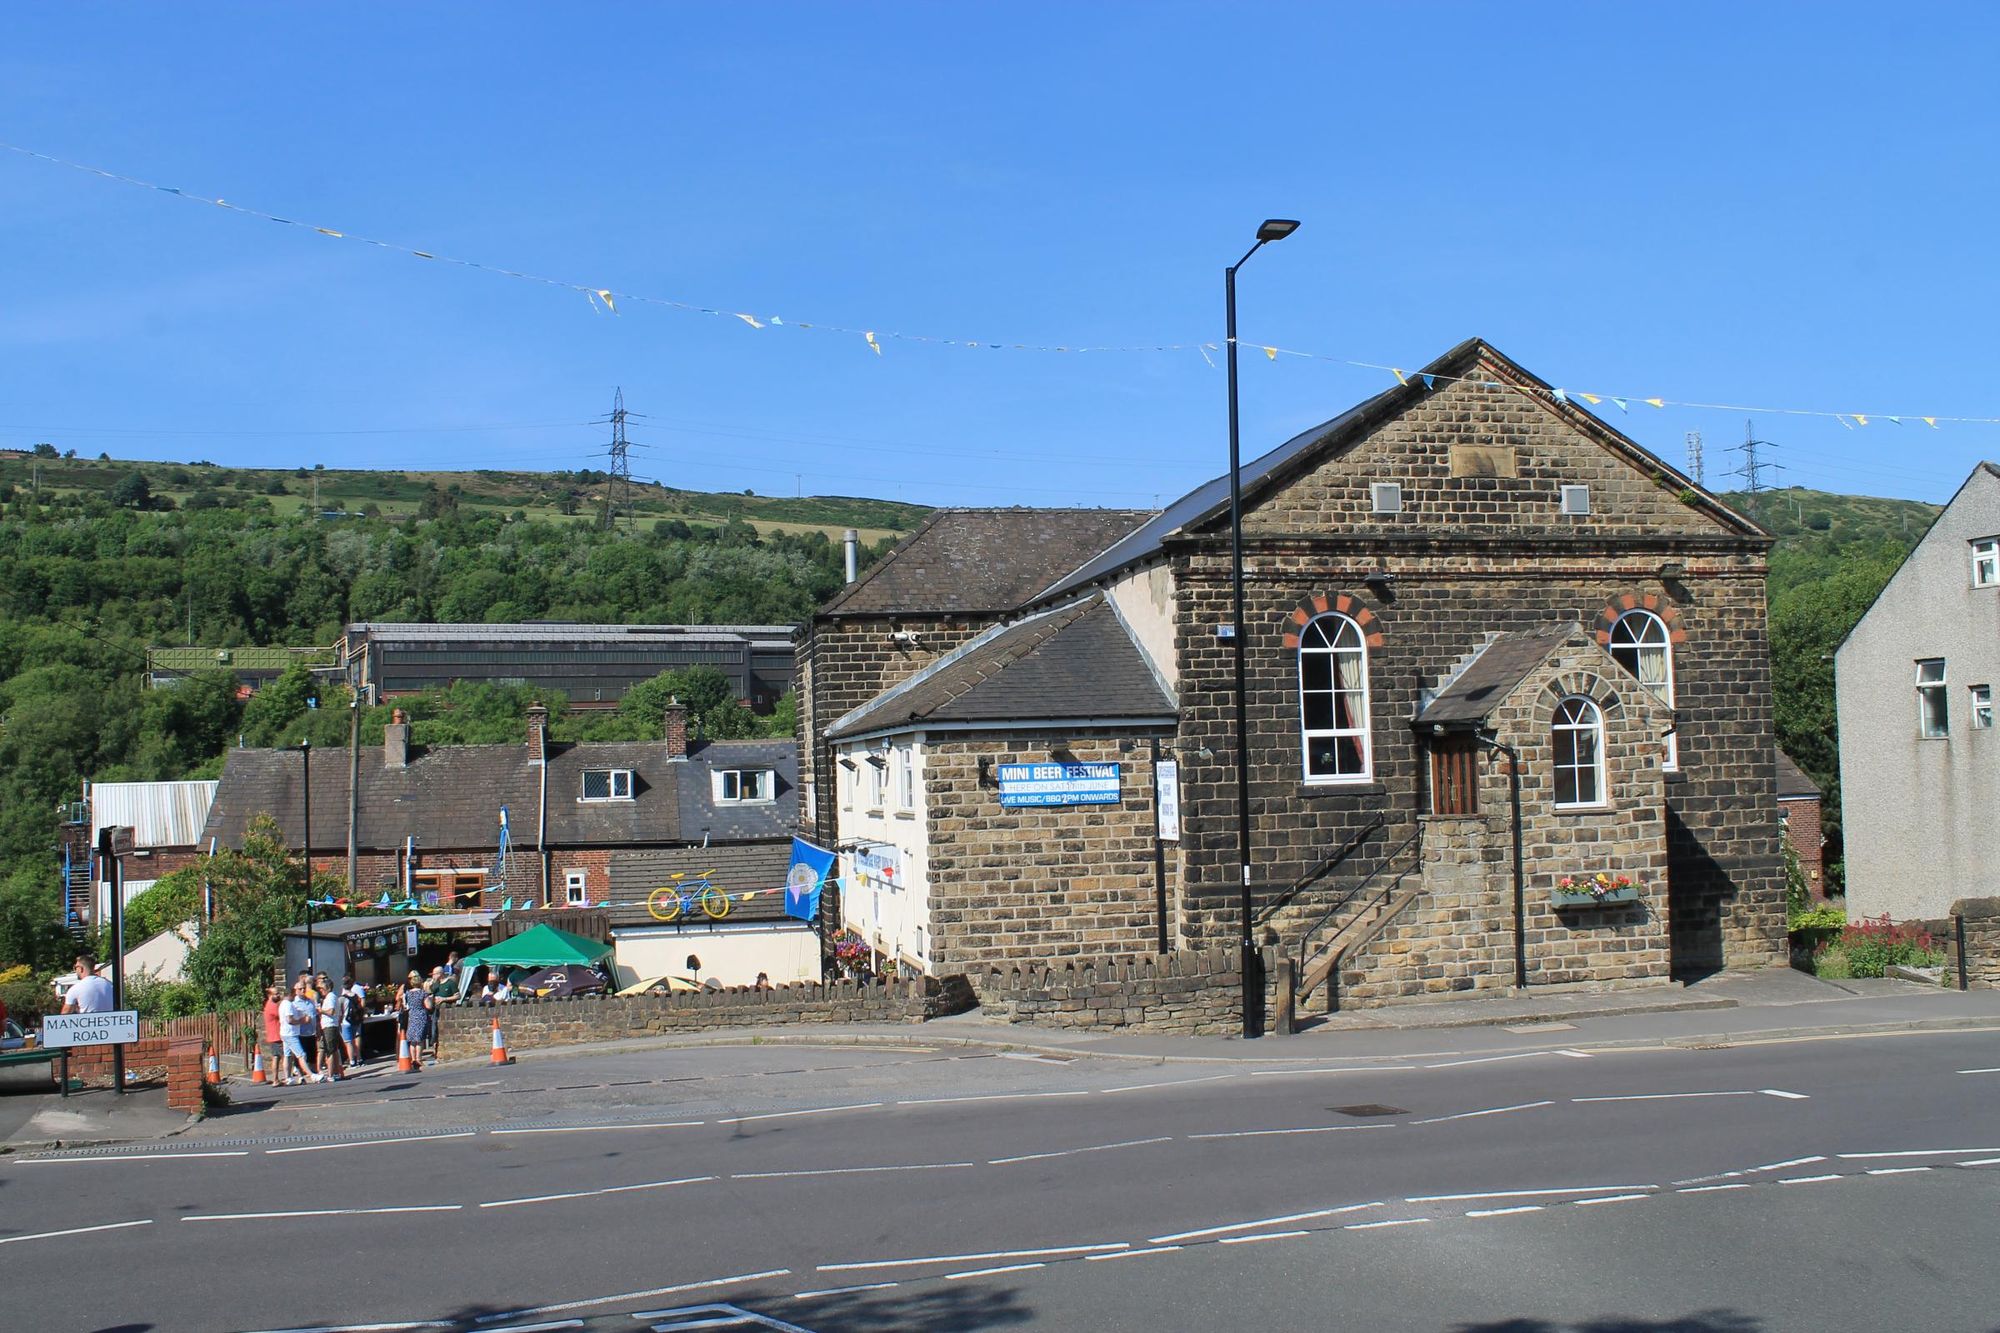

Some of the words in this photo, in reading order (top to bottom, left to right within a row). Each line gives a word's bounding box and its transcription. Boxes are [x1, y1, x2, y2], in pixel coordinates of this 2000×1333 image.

[1002, 767, 1029, 780] MINI
[1033, 766, 1062, 779] BEER
[1066, 765, 1115, 779] FESTIVAL
[1009, 783, 1031, 792] HERE
[1034, 783, 1048, 792] ON
[1050, 782, 1065, 791] SAT
[1001, 795, 1016, 804] LIVE
[1080, 792, 1118, 802] ONWARDS
[47, 1015, 134, 1030] MANCHESTER
[73, 1030, 109, 1042] ROAD
